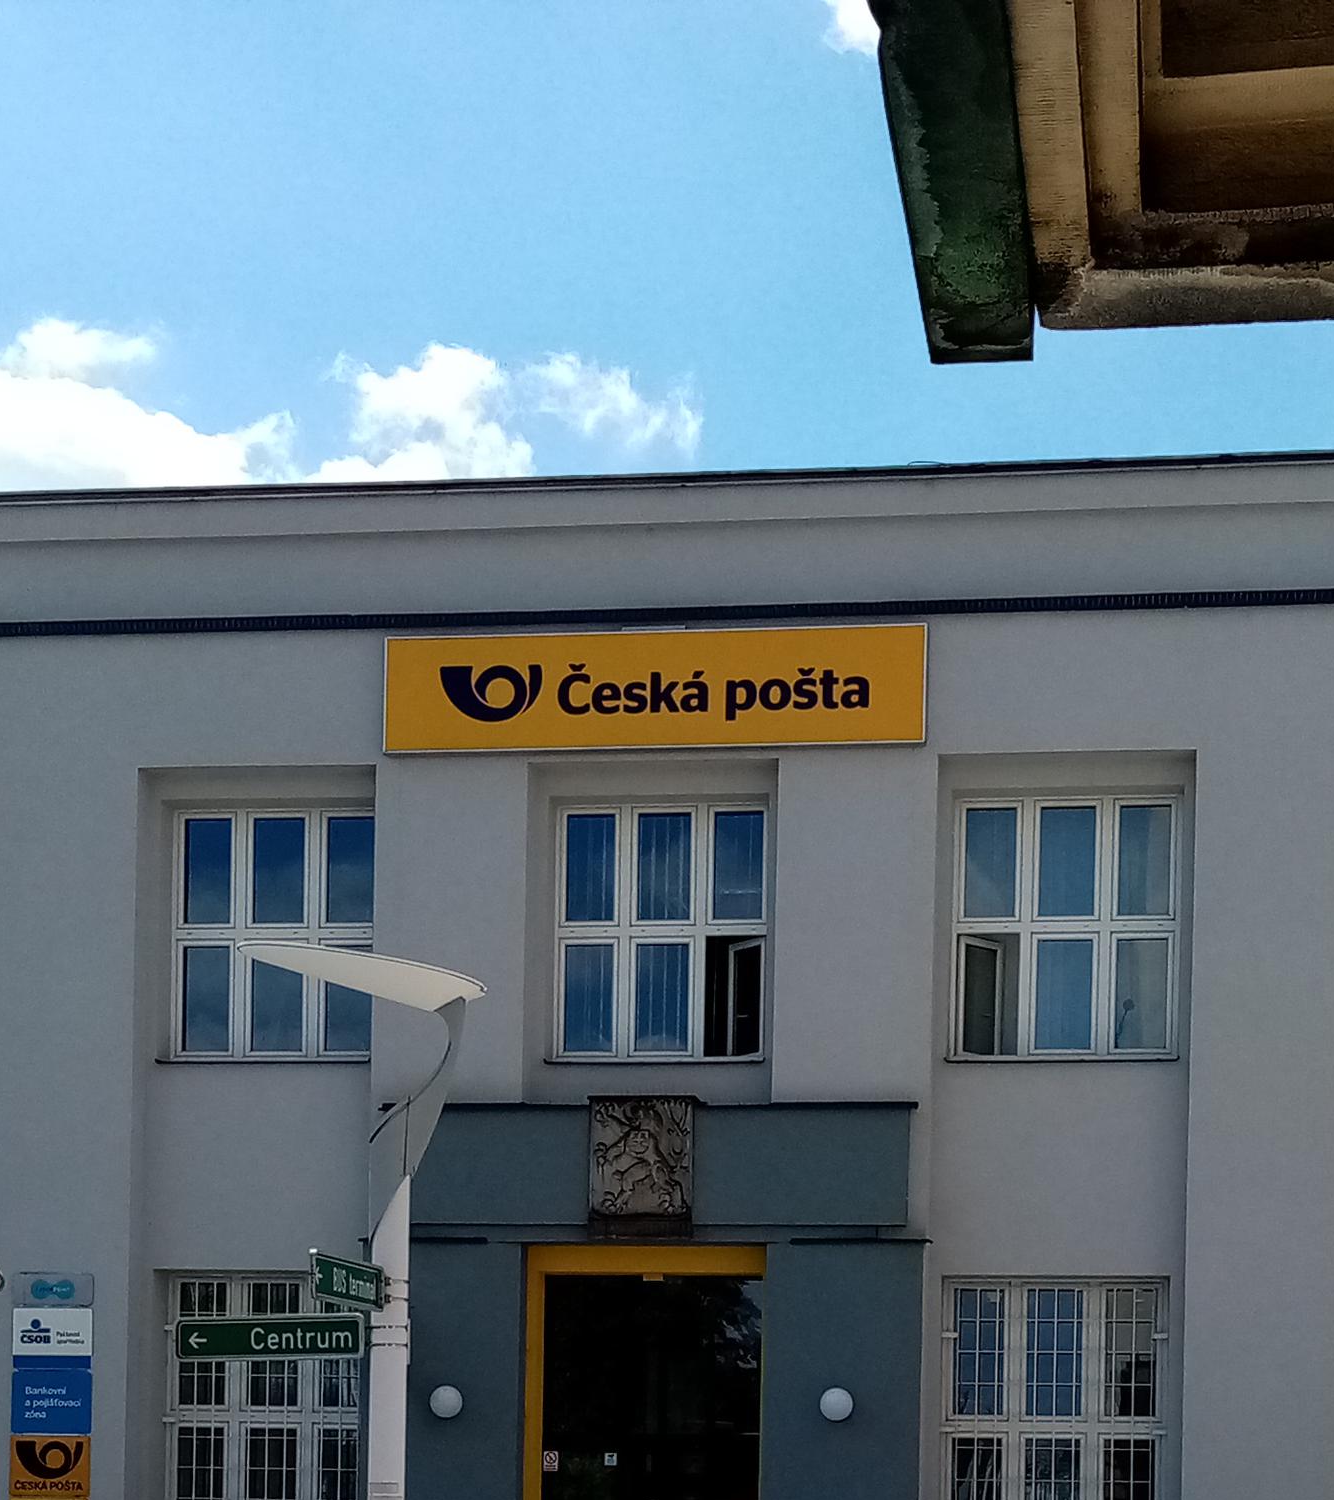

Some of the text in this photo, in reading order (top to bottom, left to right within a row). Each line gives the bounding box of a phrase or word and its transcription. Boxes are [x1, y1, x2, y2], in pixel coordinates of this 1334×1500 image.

[556, 662, 871, 722] Česká pošta
[332, 1266, 377, 1301] BUS terminal
[20, 1333, 52, 1344] ČSOB
[249, 1326, 353, 1350] Centrum
[25, 1385, 67, 1395] Bankovní
[24, 1399, 31, 1407] a
[24, 1409, 47, 1419] zóna
[14, 1480, 84, 1492] ČESKÁ POŠTA
